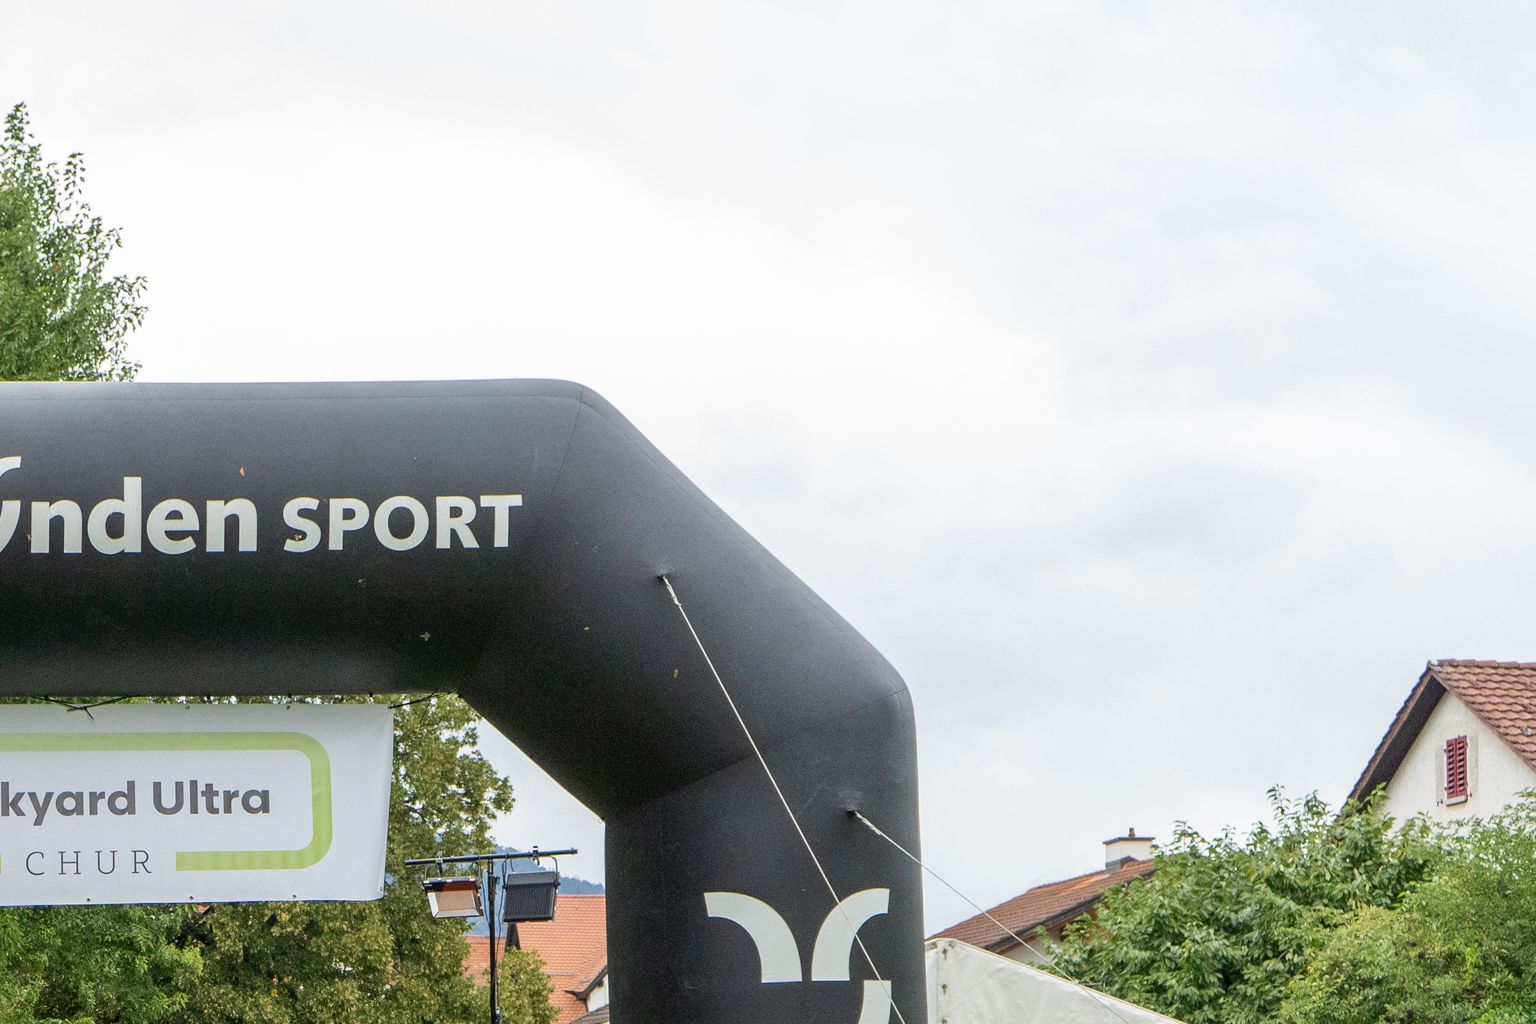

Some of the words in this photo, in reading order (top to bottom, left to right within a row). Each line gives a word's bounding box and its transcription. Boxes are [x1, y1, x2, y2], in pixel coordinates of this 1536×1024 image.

[282, 494, 523, 553] SPORT
[152, 779, 271, 815] Ultra
[25, 850, 152, 876] CHUR
